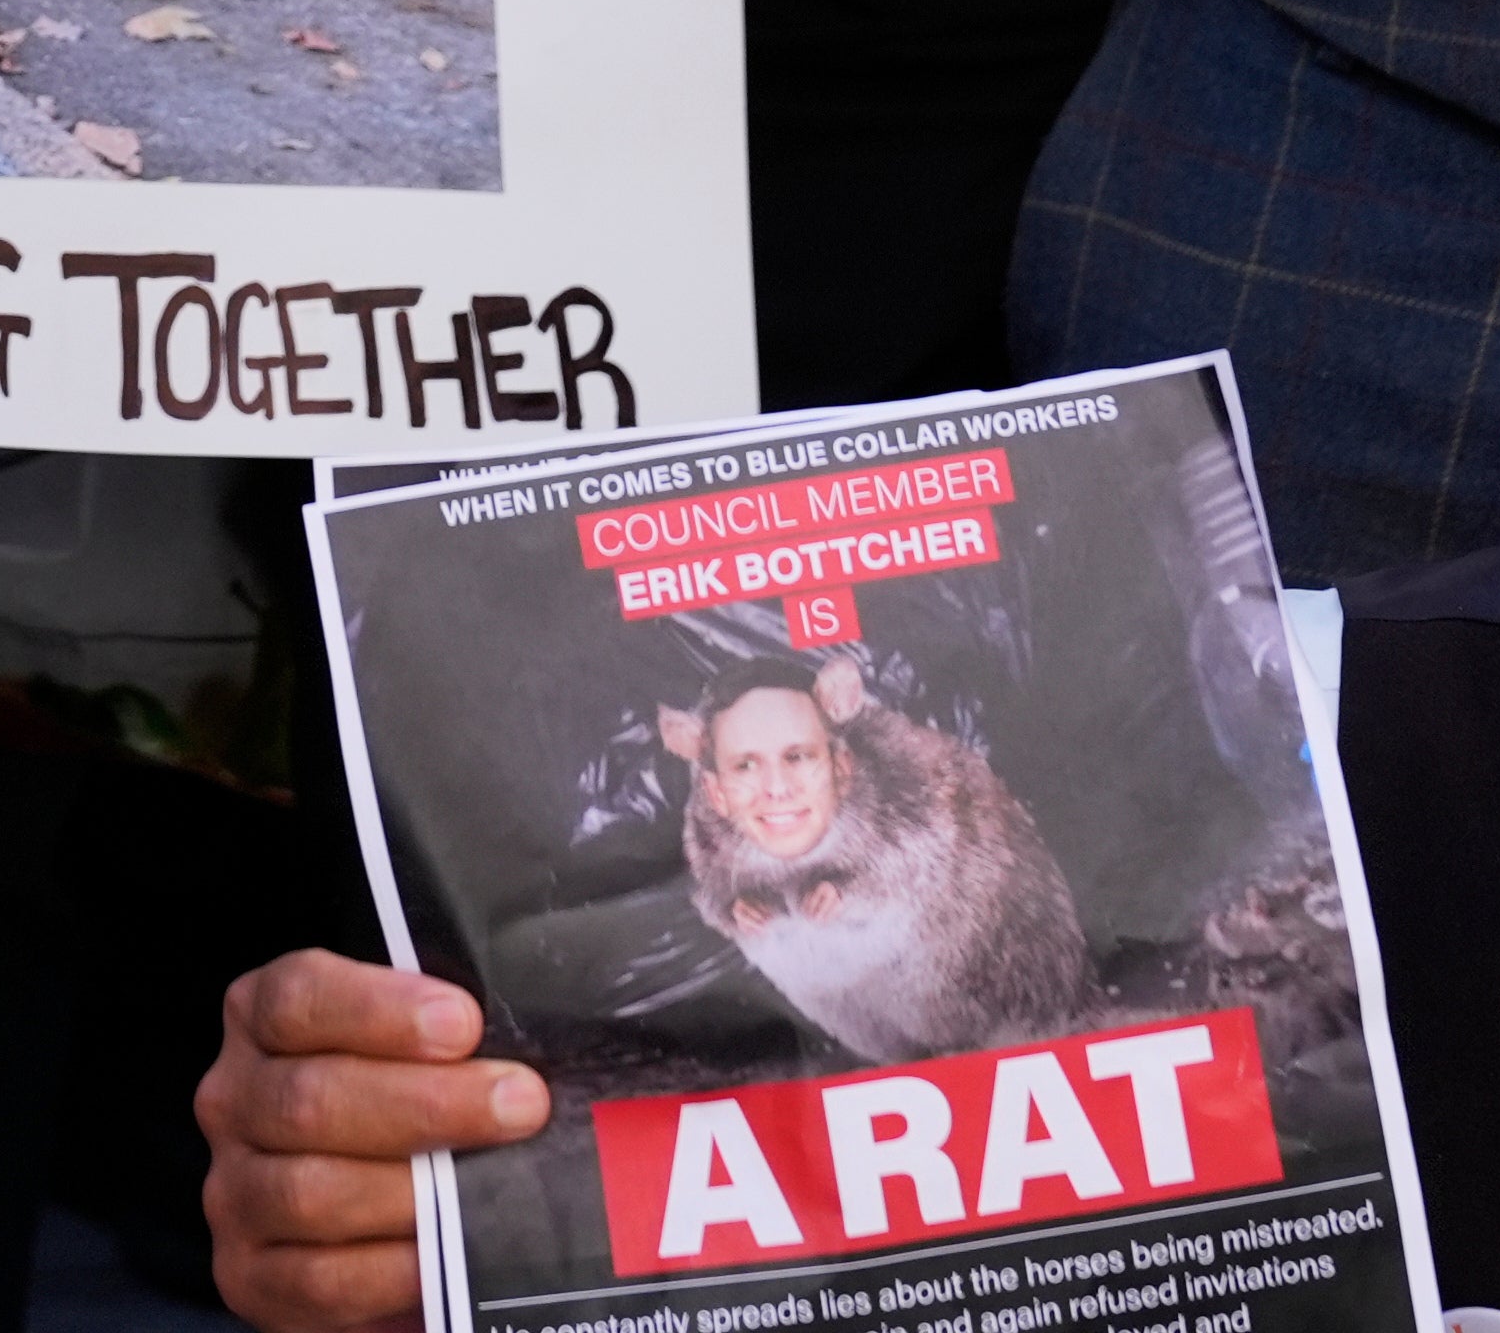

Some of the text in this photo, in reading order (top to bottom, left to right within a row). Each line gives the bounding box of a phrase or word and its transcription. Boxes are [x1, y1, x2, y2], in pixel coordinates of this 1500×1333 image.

[61, 252, 640, 430] TOGETHER
[441, 488, 537, 526] WHEN
[543, 482, 570, 510] IT
[579, 463, 692, 503] COMES
[696, 456, 739, 483] TO
[747, 441, 828, 475] BLUE
[833, 421, 957, 461] COLLAR
[962, 395, 1118, 441] WORKERS
[594, 459, 1000, 556] COUNCIL MEMBER
[619, 519, 985, 611] ERIK BOTTCHER
[800, 598, 839, 637] IS
[657, 1025, 1215, 1261] A RAT
[697, 1293, 814, 1333] spreads
[820, 1289, 872, 1320] lies
[879, 1271, 965, 1312] about
[970, 1264, 1018, 1296] the
[1024, 1250, 1125, 1287] horses
[1131, 1233, 1215, 1269] being
[1222, 1199, 1383, 1254] mistreated.
[917, 1308, 973, 1333] and
[981, 1297, 1062, 1333] again
[1069, 1274, 1178, 1322] refused
[1184, 1255, 1336, 1301] invitations
[1195, 1302, 1251, 1333] and
